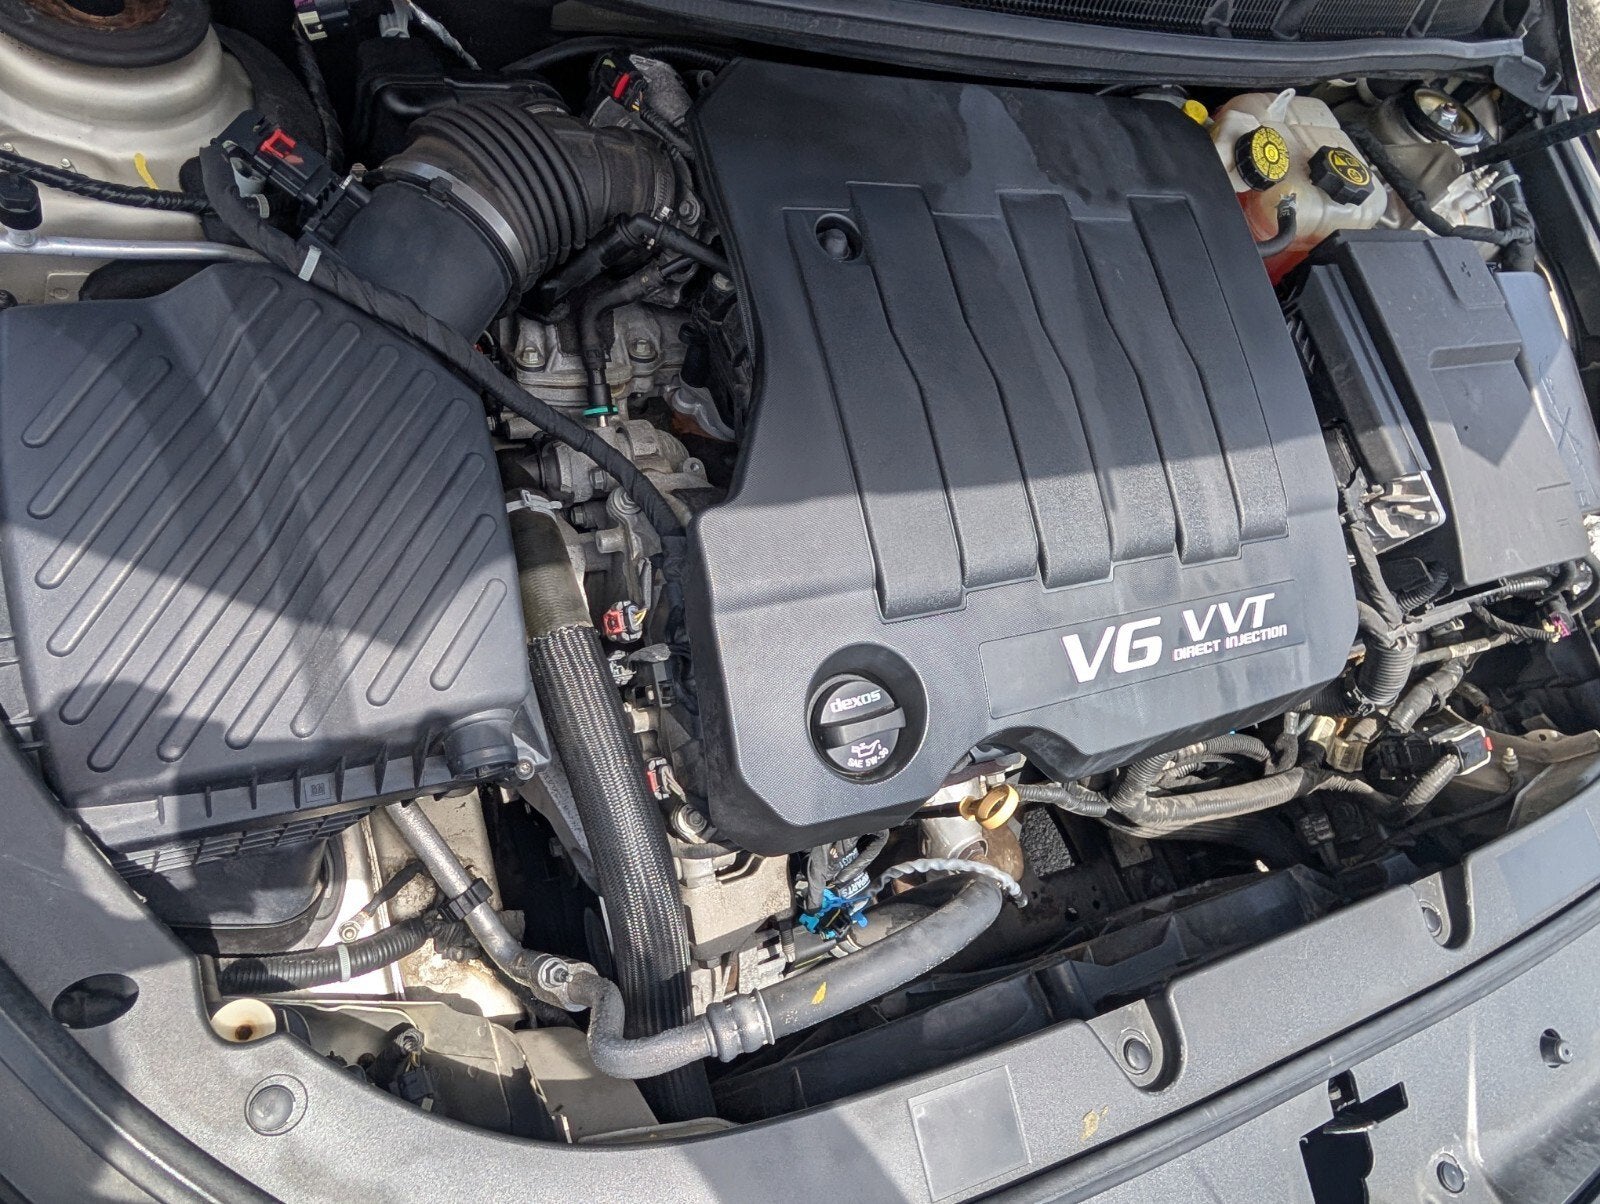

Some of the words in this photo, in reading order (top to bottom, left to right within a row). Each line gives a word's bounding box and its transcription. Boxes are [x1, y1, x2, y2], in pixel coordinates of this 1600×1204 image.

[1061, 616, 1162, 683] V6
[1182, 592, 1275, 642] VVT
[1173, 638, 1221, 662] DIRECT
[1226, 624, 1288, 650] INJECTION
[830, 689, 881, 713] dexos
[847, 757, 863, 769] SAE
[865, 747, 889, 767] 5W-30
